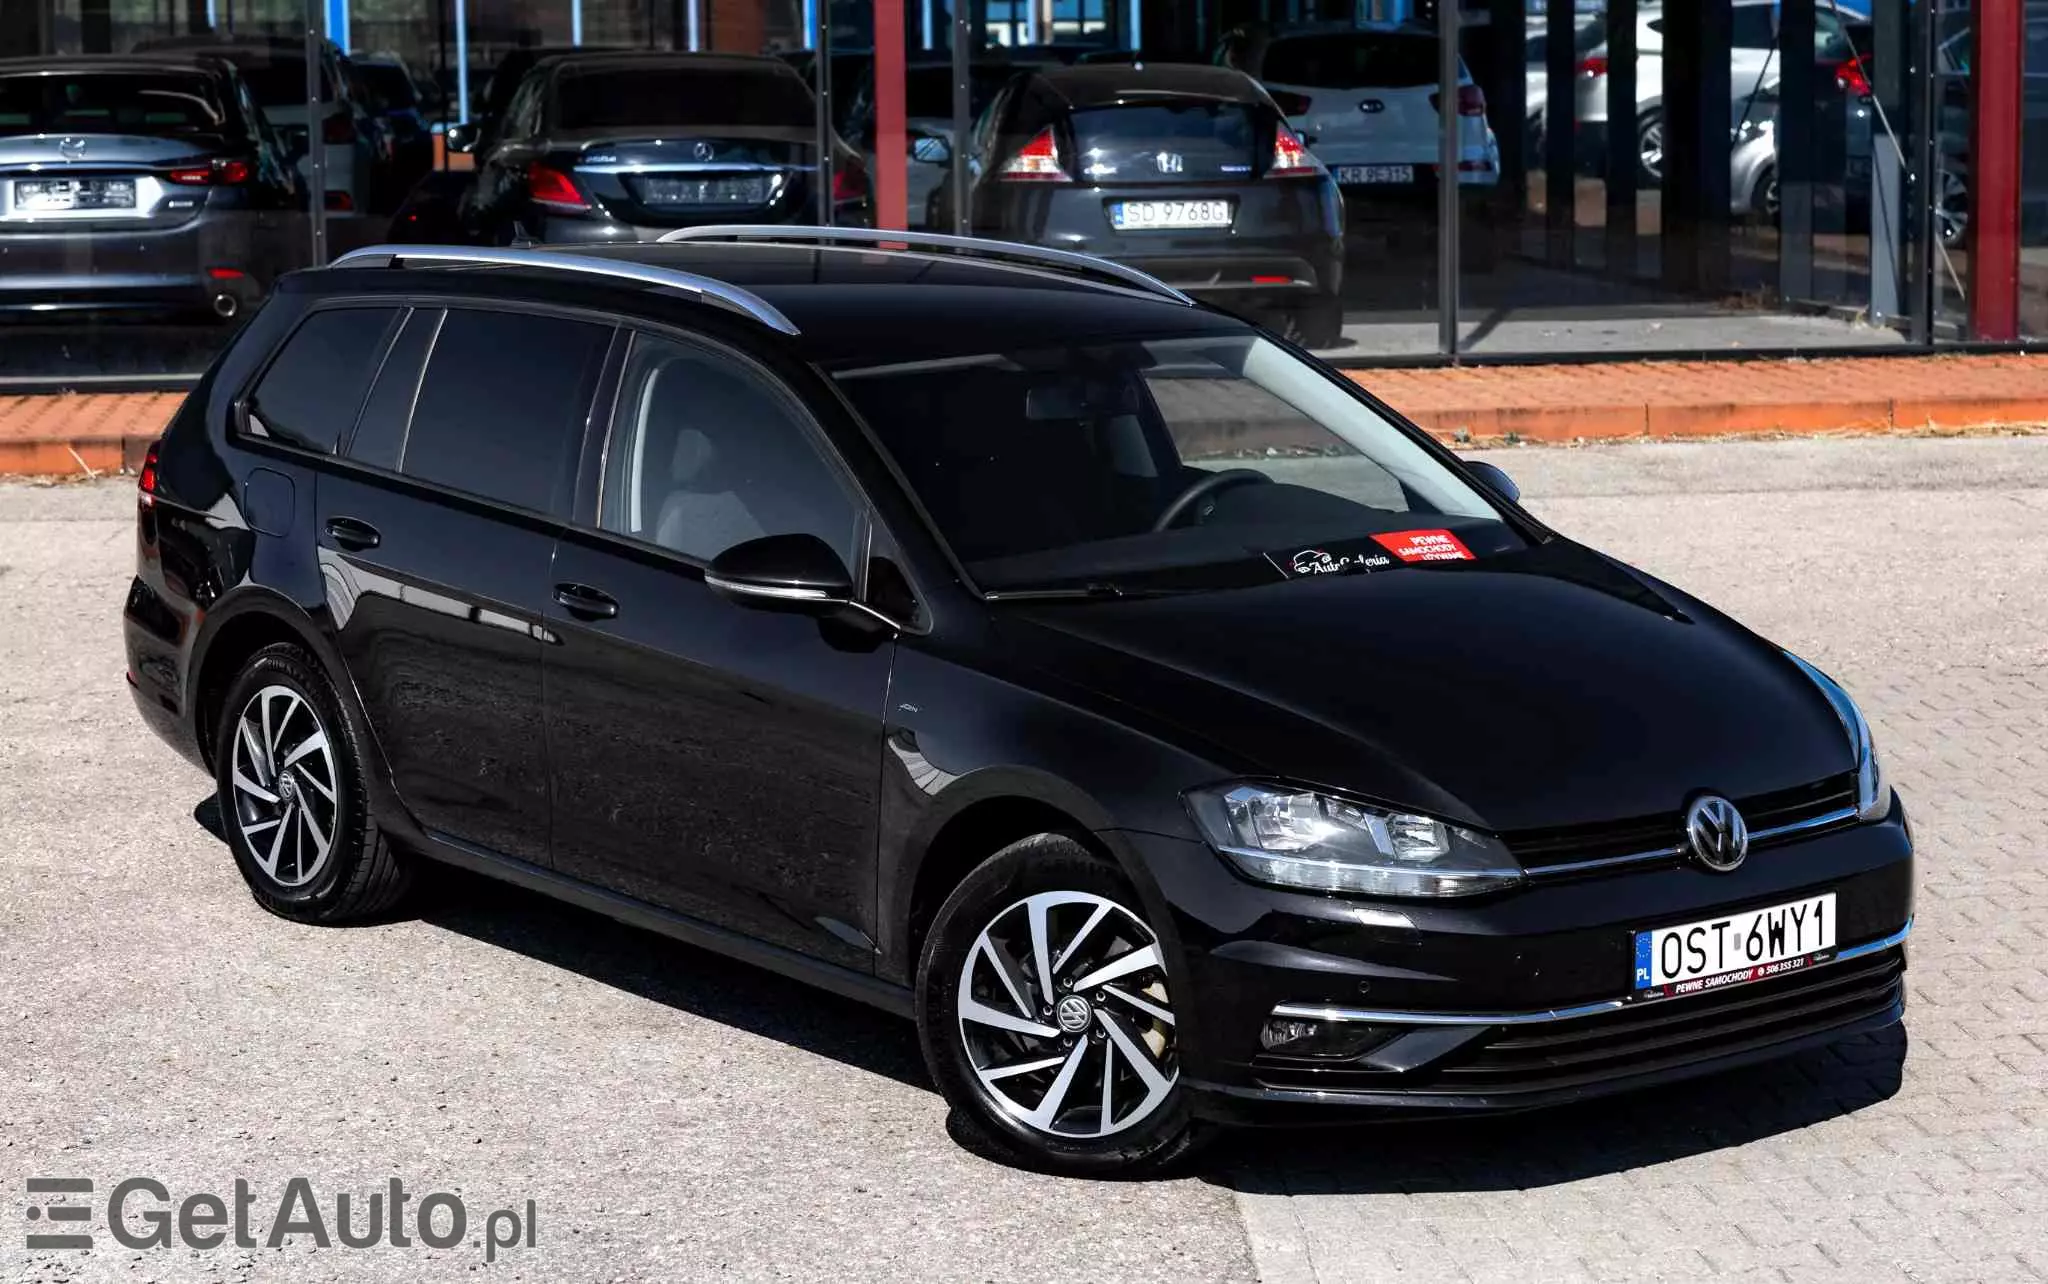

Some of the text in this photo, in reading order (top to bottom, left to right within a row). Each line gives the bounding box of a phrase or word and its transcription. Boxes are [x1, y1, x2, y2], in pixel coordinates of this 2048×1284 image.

[1127, 203, 1156, 223] SD
[1661, 900, 1823, 979] OST 6WY1
[1636, 967, 1651, 982] PL
[1675, 980, 1704, 994] PEWNE
[1705, 968, 1754, 988] SAMOCHODY
